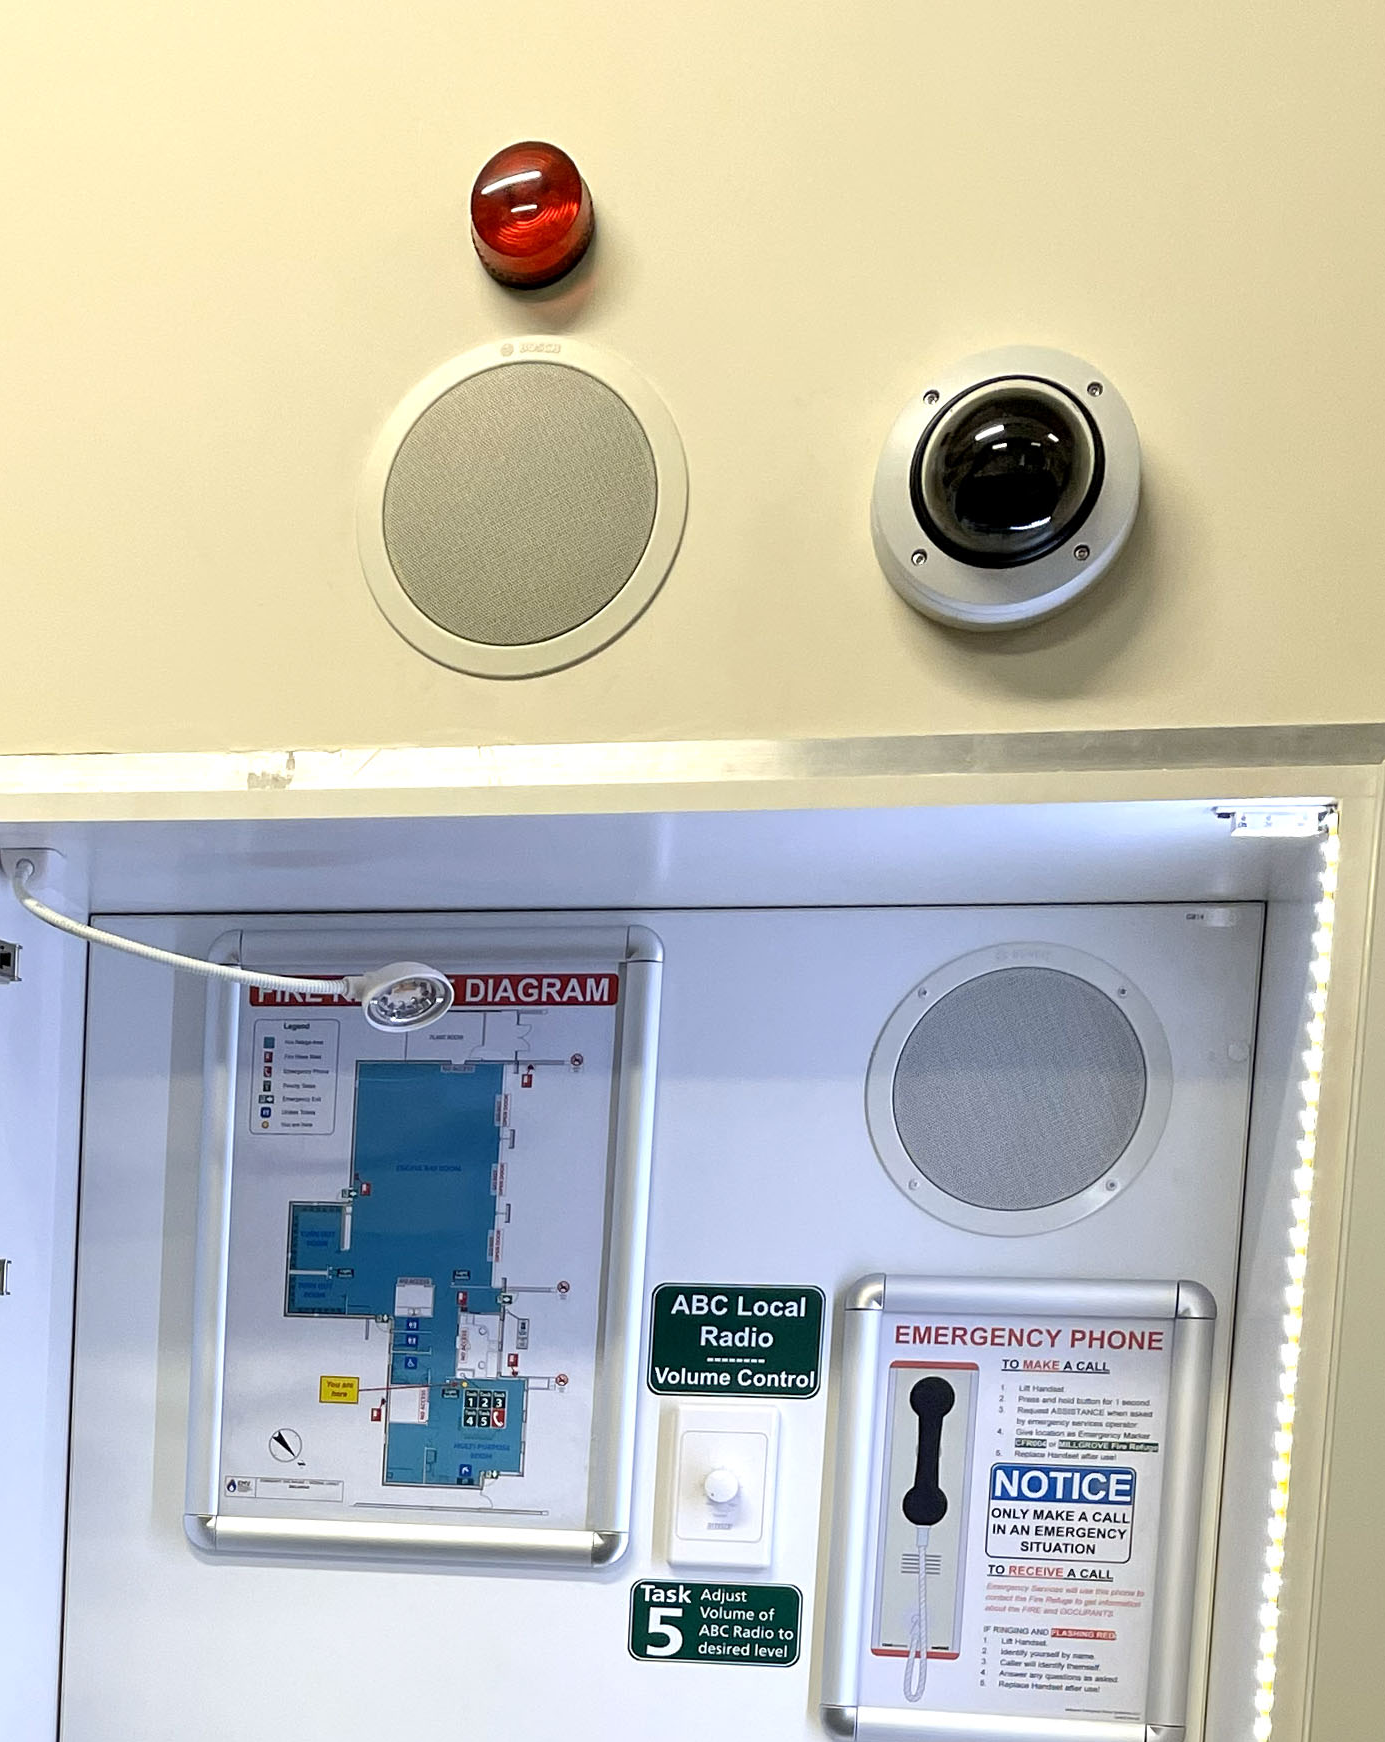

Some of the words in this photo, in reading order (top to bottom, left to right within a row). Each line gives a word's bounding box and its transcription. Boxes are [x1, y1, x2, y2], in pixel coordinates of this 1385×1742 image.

[465, 978, 608, 1002] DIAGRAM
[670, 1294, 728, 1315] ABC
[737, 1296, 805, 1317] Local
[700, 1326, 773, 1348] Radio
[895, 1325, 1061, 1348] EMERGENCY
[1070, 1329, 1163, 1351] PHONE
[1001, 1359, 1020, 1370] TO
[1023, 1360, 1060, 1371] MAKE
[1064, 1361, 1074, 1371] A
[1076, 1361, 1110, 1372] CALL
[654, 1367, 730, 1385] Volume
[737, 1369, 816, 1391] Control
[995, 1470, 1132, 1502] NOTICE
[991, 1507, 1029, 1519] ONLY
[1032, 1509, 1074, 1521] MAKE
[1077, 1511, 1088, 1522] A
[1092, 1511, 1131, 1526] CALL
[992, 1523, 1006, 1535] IN
[1009, 1524, 1029, 1536] AN
[1034, 1525, 1126, 1540] EMERGENCY
[1020, 1541, 1095, 1555] SITUATION
